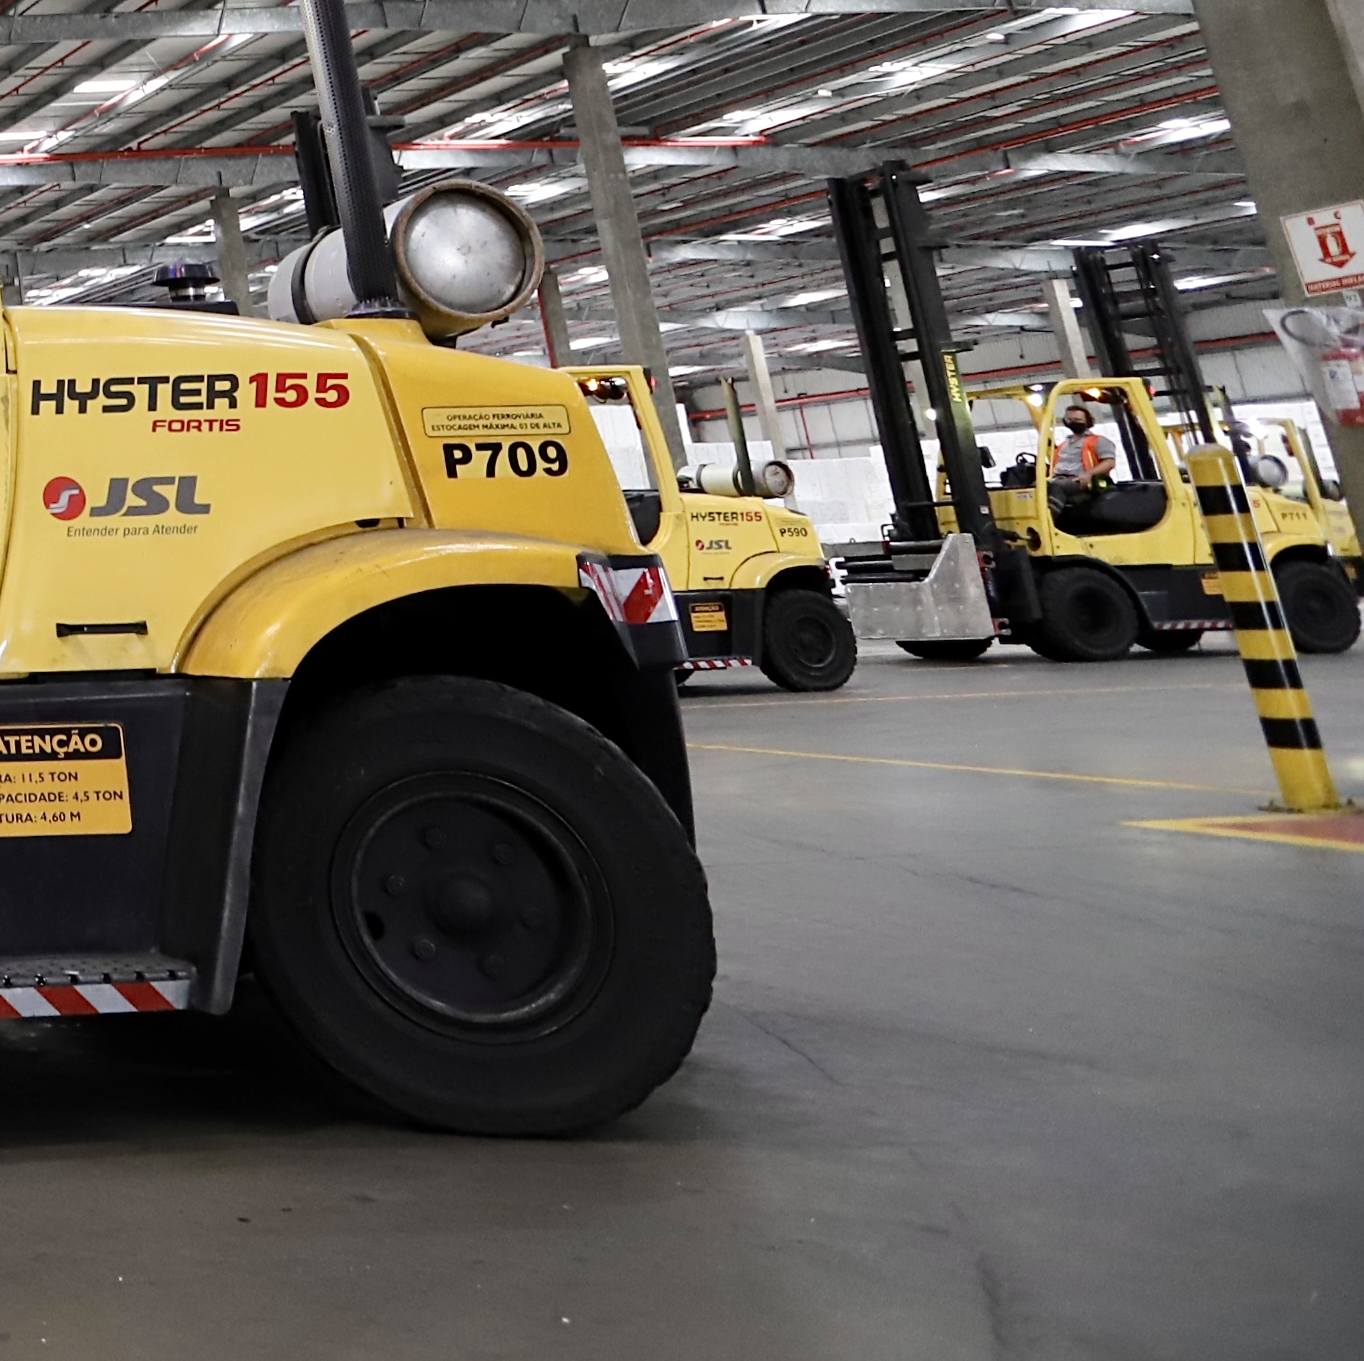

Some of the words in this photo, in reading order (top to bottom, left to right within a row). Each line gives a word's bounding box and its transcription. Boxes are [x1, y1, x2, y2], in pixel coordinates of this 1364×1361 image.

[943, 354, 963, 402] HYSTER
[30, 373, 240, 415] HYSTER
[248, 372, 350, 409] 155
[446, 412, 490, 422] OPERAÇÃO
[492, 411, 544, 420] FERROVIÁRIA
[151, 418, 241, 433] FORTIS
[431, 423, 480, 432] ESTOCAGEM
[530, 422, 541, 430] DE
[542, 421, 563, 429] ALTA
[442, 440, 569, 479] P709
[89, 475, 212, 517] JSL
[690, 511, 739, 522] HYSTER
[739, 511, 763, 522] 155
[66, 524, 119, 537] Entender
[122, 526, 150, 538] para
[152, 523, 199, 535] Atender
[779, 527, 808, 537] P590
[705, 539, 732, 550] JSL
[21, 772, 45, 784] 11,5
[49, 771, 78, 782] TON
[72, 791, 90, 803] 4,5
[94, 790, 124, 801] TON
[40, 811, 66, 823] 4,60
[70, 811, 81, 822] M
